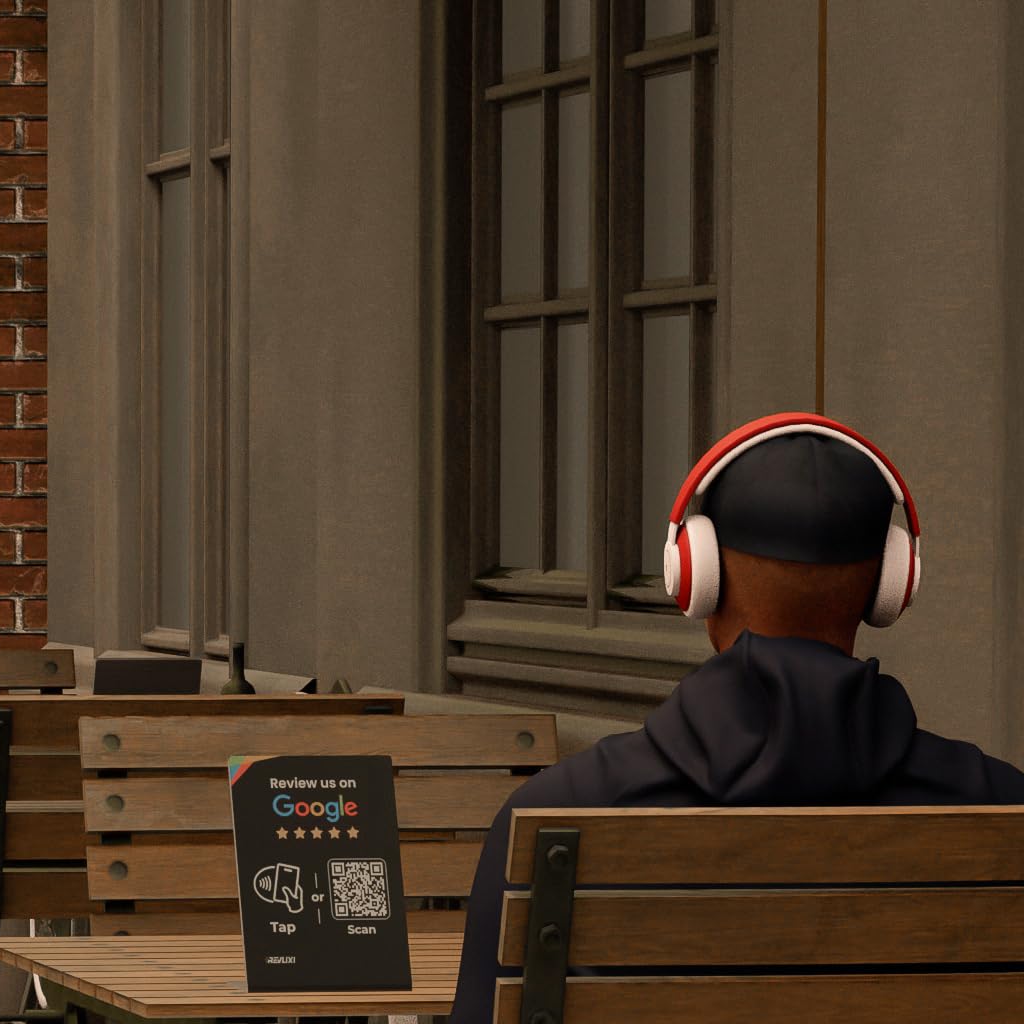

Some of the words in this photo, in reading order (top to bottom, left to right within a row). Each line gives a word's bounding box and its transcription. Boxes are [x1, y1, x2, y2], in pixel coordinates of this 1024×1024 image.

[270, 777, 317, 789] Review
[320, 779, 336, 789] us
[339, 778, 357, 789] on
[272, 794, 358, 823] Google
[311, 893, 325, 902] or
[270, 921, 297, 935] Tap
[347, 925, 377, 935] Scan
